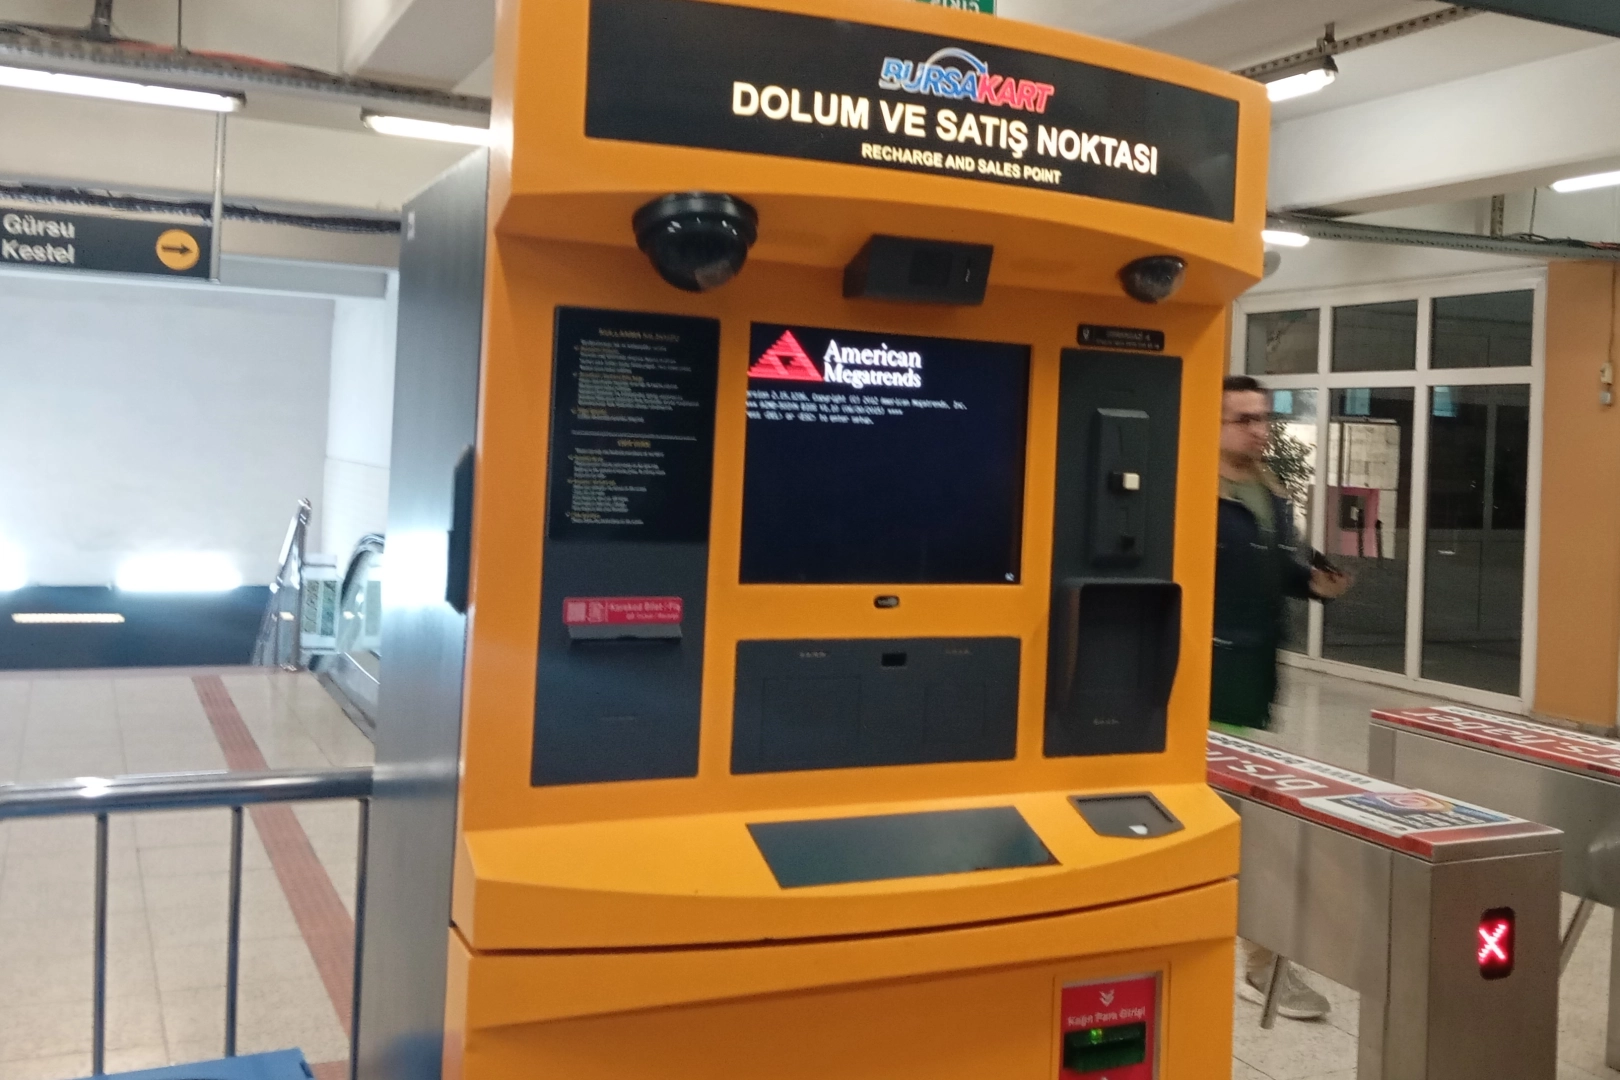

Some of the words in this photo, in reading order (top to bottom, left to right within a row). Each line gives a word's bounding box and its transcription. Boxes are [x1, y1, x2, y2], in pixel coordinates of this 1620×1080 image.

[879, 56, 1054, 114] BURSAKART
[732, 81, 870, 130] DOLUM
[879, 100, 927, 137] VE
[935, 108, 1029, 159] SATIŞ
[1037, 124, 1158, 175] NOKTASI
[861, 142, 943, 168] RECHARGE
[944, 155, 976, 172] AND
[977, 158, 1021, 179] SALES
[1023, 164, 1062, 184] POINT
[3, 213, 76, 239] Gürsu
[2, 238, 76, 264] Kestel
[823, 338, 923, 369] American
[823, 361, 923, 389] Megatrends
